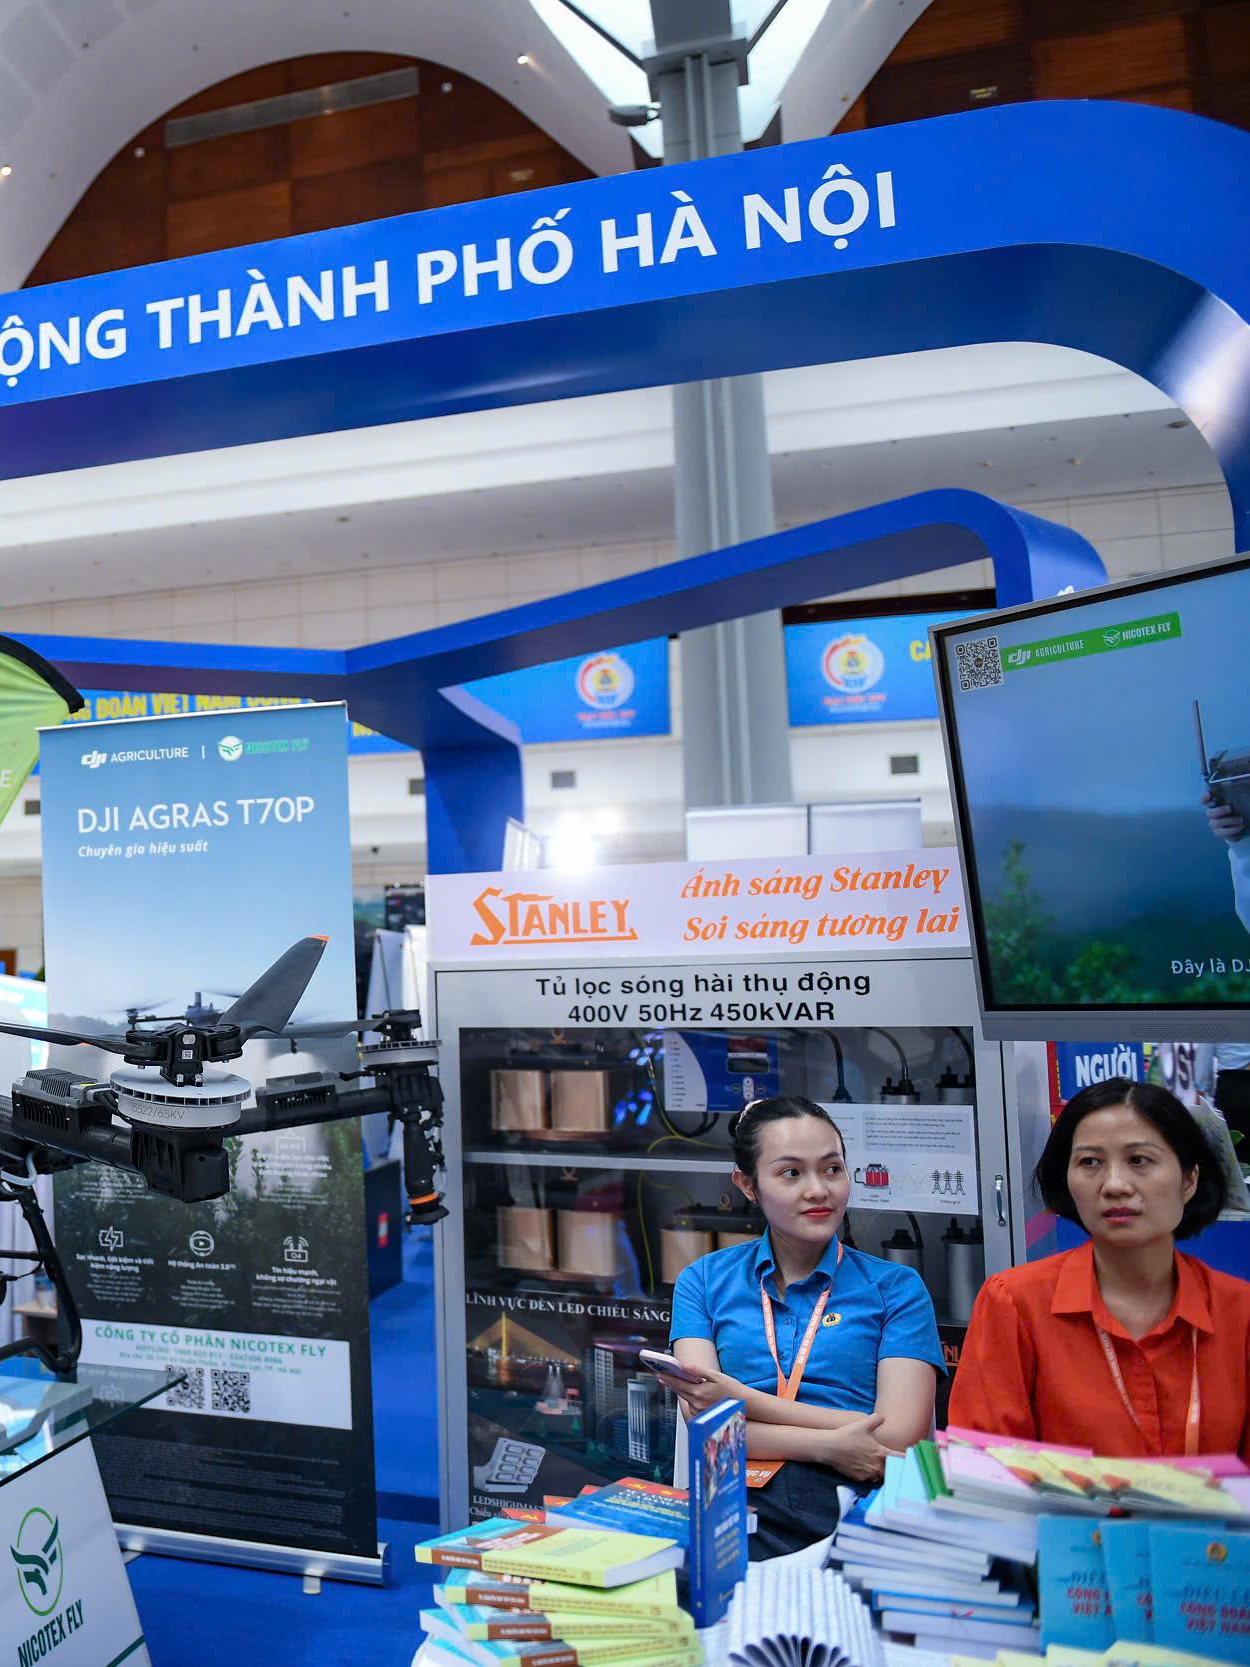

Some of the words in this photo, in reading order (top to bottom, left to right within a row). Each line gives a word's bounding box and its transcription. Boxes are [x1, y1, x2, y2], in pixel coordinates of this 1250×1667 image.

[146, 267, 390, 351] THÀNH
[416, 206, 574, 306] PHỐ
[601, 190, 718, 274] HÀ
[744, 163, 896, 251] NỘI
[1035, 639, 1085, 658] AGRICULTURE
[1122, 625, 1156, 641] NICOTEX
[1157, 621, 1172, 634] FLY
[110, 747, 189, 763] AGRICULTURE
[78, 806, 119, 833] DJI
[129, 800, 230, 831] AGRAS
[236, 796, 315, 825] T70P
[78, 843, 123, 858] Chuyên
[126, 844, 145, 858] gia
[149, 840, 177, 856] hiệu
[180, 839, 209, 853] suất
[681, 868, 741, 900] Ánh
[747, 865, 822, 900] sáng
[829, 863, 950, 896] Stanley
[470, 886, 638, 947] STANLEY
[683, 916, 728, 942] Soi
[734, 912, 809, 945] sáng
[816, 909, 911, 942] tương
[916, 905, 960, 934] lai
[535, 976, 567, 997] Tủ
[573, 976, 612, 999] lọc
[620, 975, 684, 1000] sóng
[694, 973, 734, 994] hài
[742, 973, 789, 997] thụ
[797, 970, 871, 996] động
[1171, 959, 1205, 978] Đây
[1210, 958, 1227, 974] là
[568, 1004, 629, 1024] 400V
[638, 1003, 703, 1022] 50Hz
[710, 1000, 836, 1022] 450kVAR
[1075, 1043, 1139, 1088] NGƯỜI
[466, 1292, 496, 1306] LĨNH
[499, 1296, 528, 1311] VỰC
[529, 1296, 556, 1313] ĐÈN
[558, 1302, 584, 1315] LED
[632, 1305, 670, 1323] SÁNG
[94, 1326, 136, 1341] CÔNG
[141, 1330, 156, 1342] TY
[185, 1333, 226, 1350] PHẦN
[230, 1337, 296, 1355] NICOTEX
[300, 1343, 327, 1357] FLY
[18, 1613, 67, 1667] NICOTEX
[65, 1598, 84, 1635] FLY
